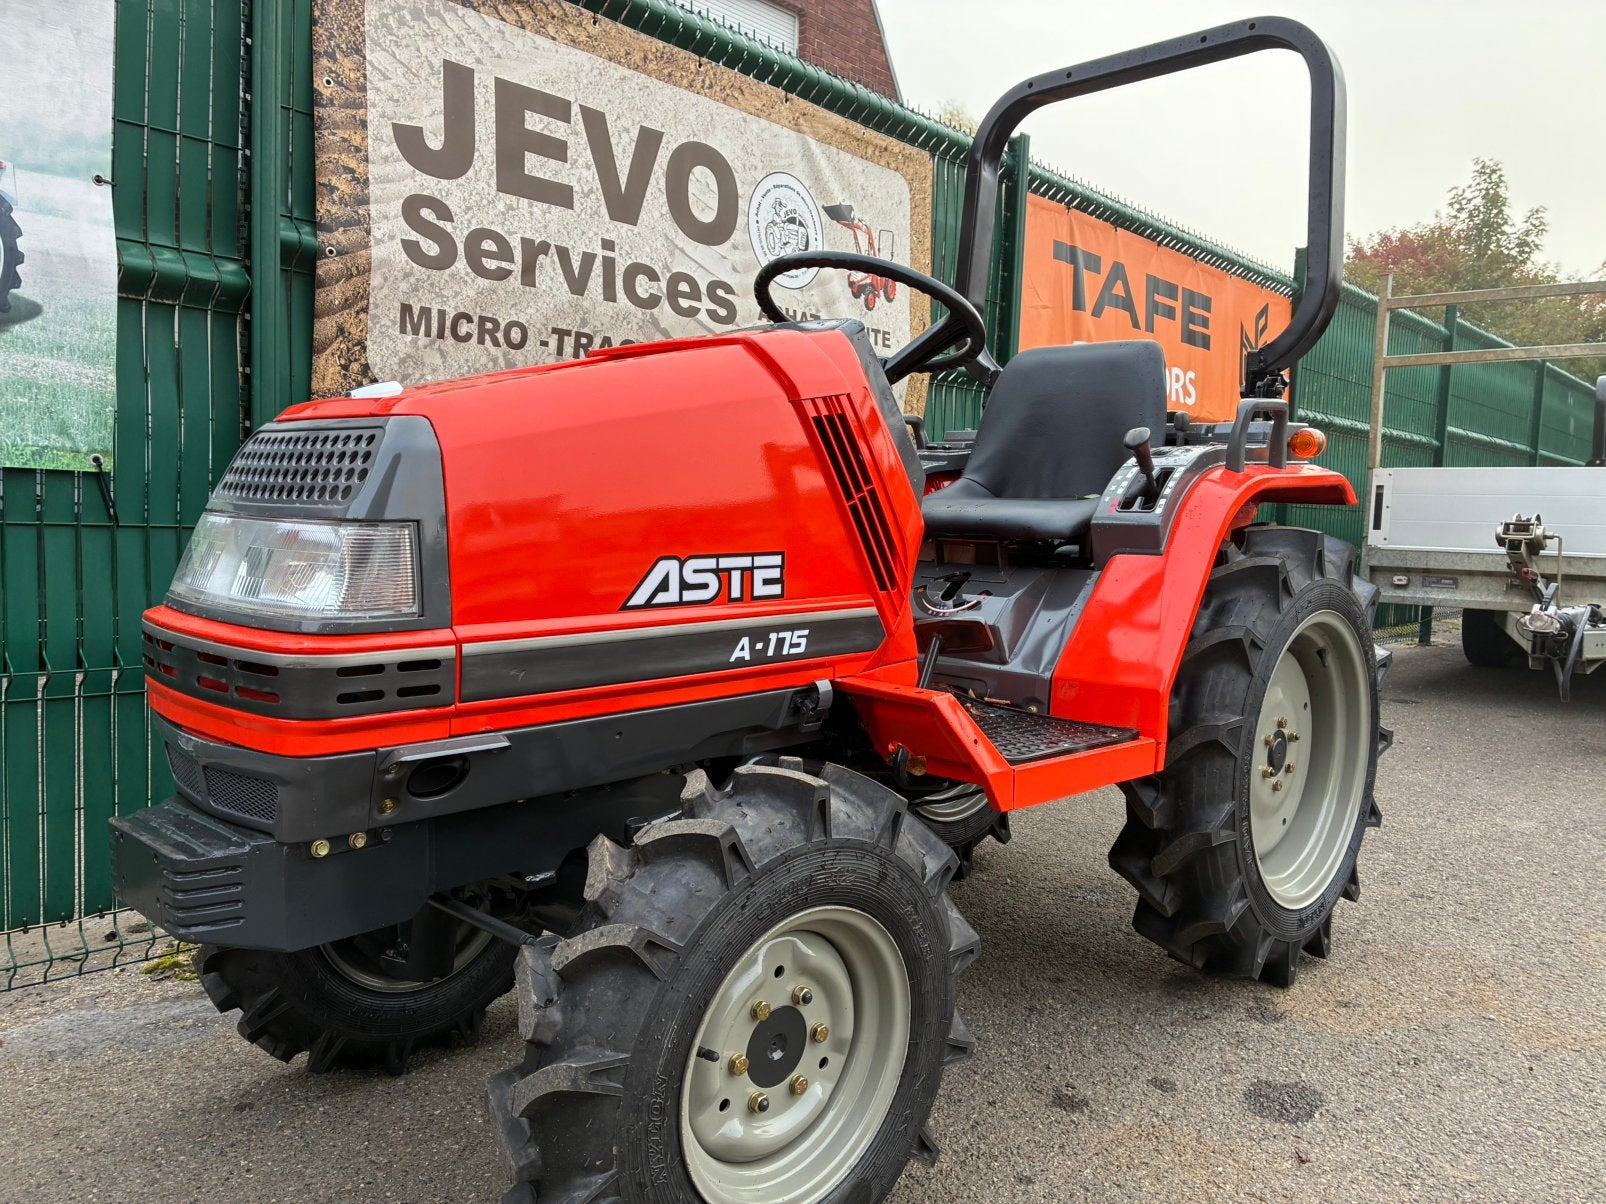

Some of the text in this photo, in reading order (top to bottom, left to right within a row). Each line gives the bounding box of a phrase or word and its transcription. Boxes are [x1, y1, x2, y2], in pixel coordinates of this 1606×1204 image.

[391, 58, 739, 246] JEVO
[783, 208, 798, 219] JEVO
[400, 193, 737, 326] Services
[1053, 240, 1212, 352] TAFE
[399, 303, 529, 351] MICRO
[619, 552, 785, 610] ASTE
